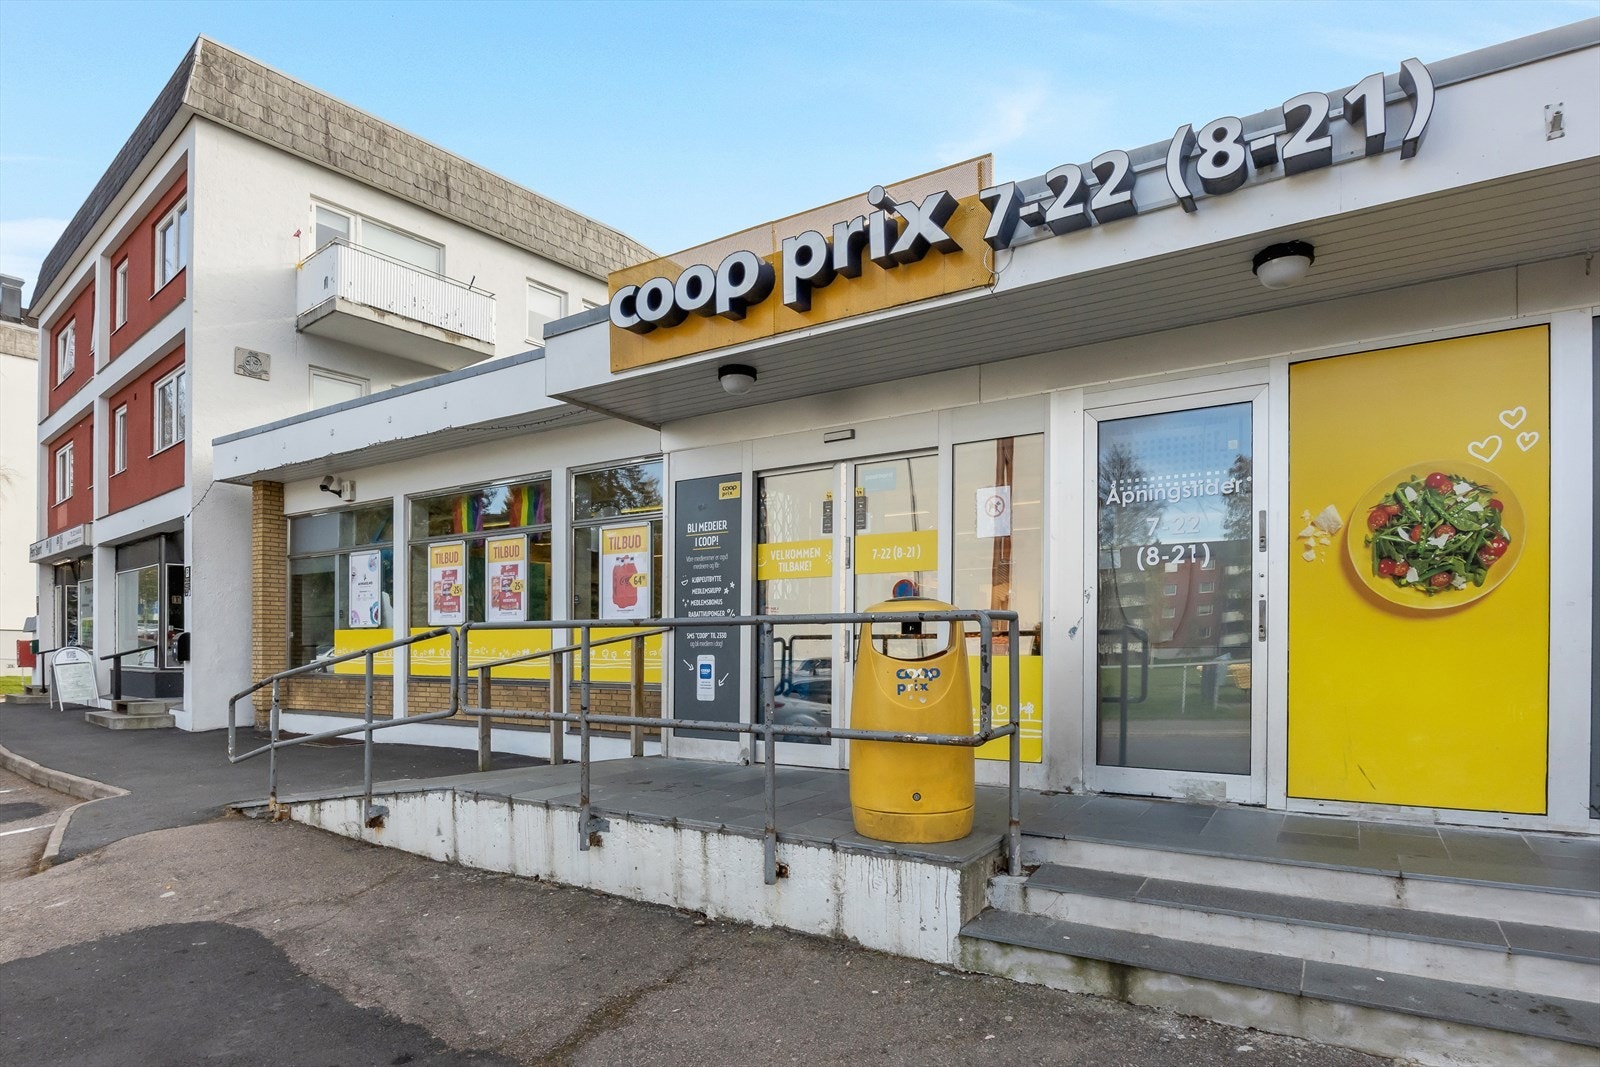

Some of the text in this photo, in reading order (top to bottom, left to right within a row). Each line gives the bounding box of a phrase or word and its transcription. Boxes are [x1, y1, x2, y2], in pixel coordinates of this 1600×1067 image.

[978, 57, 1436, 250] 7-22 (8-21)
[609, 185, 956, 332] coop prix
[1105, 479, 1243, 507] Åpningstider
[687, 520, 728, 533] BLI MEDEIER
[1146, 514, 1200, 537] 7-22
[608, 534, 642, 550] TILBUD
[698, 535, 719, 546] COOP!
[435, 551, 459, 565] TILBUD
[493, 545, 520, 559] TILBUD
[770, 547, 821, 560] VELKOMMEN
[872, 547, 891, 560] 7-22
[1136, 543, 1211, 571] (8-21)
[778, 560, 812, 573] TILBAKE!
[691, 575, 722, 583] KJØPEUTBYTTE
[691, 587, 722, 595] MEDLEMSKUPP
[896, 667, 941, 682] coop
[897, 679, 929, 696] prix
